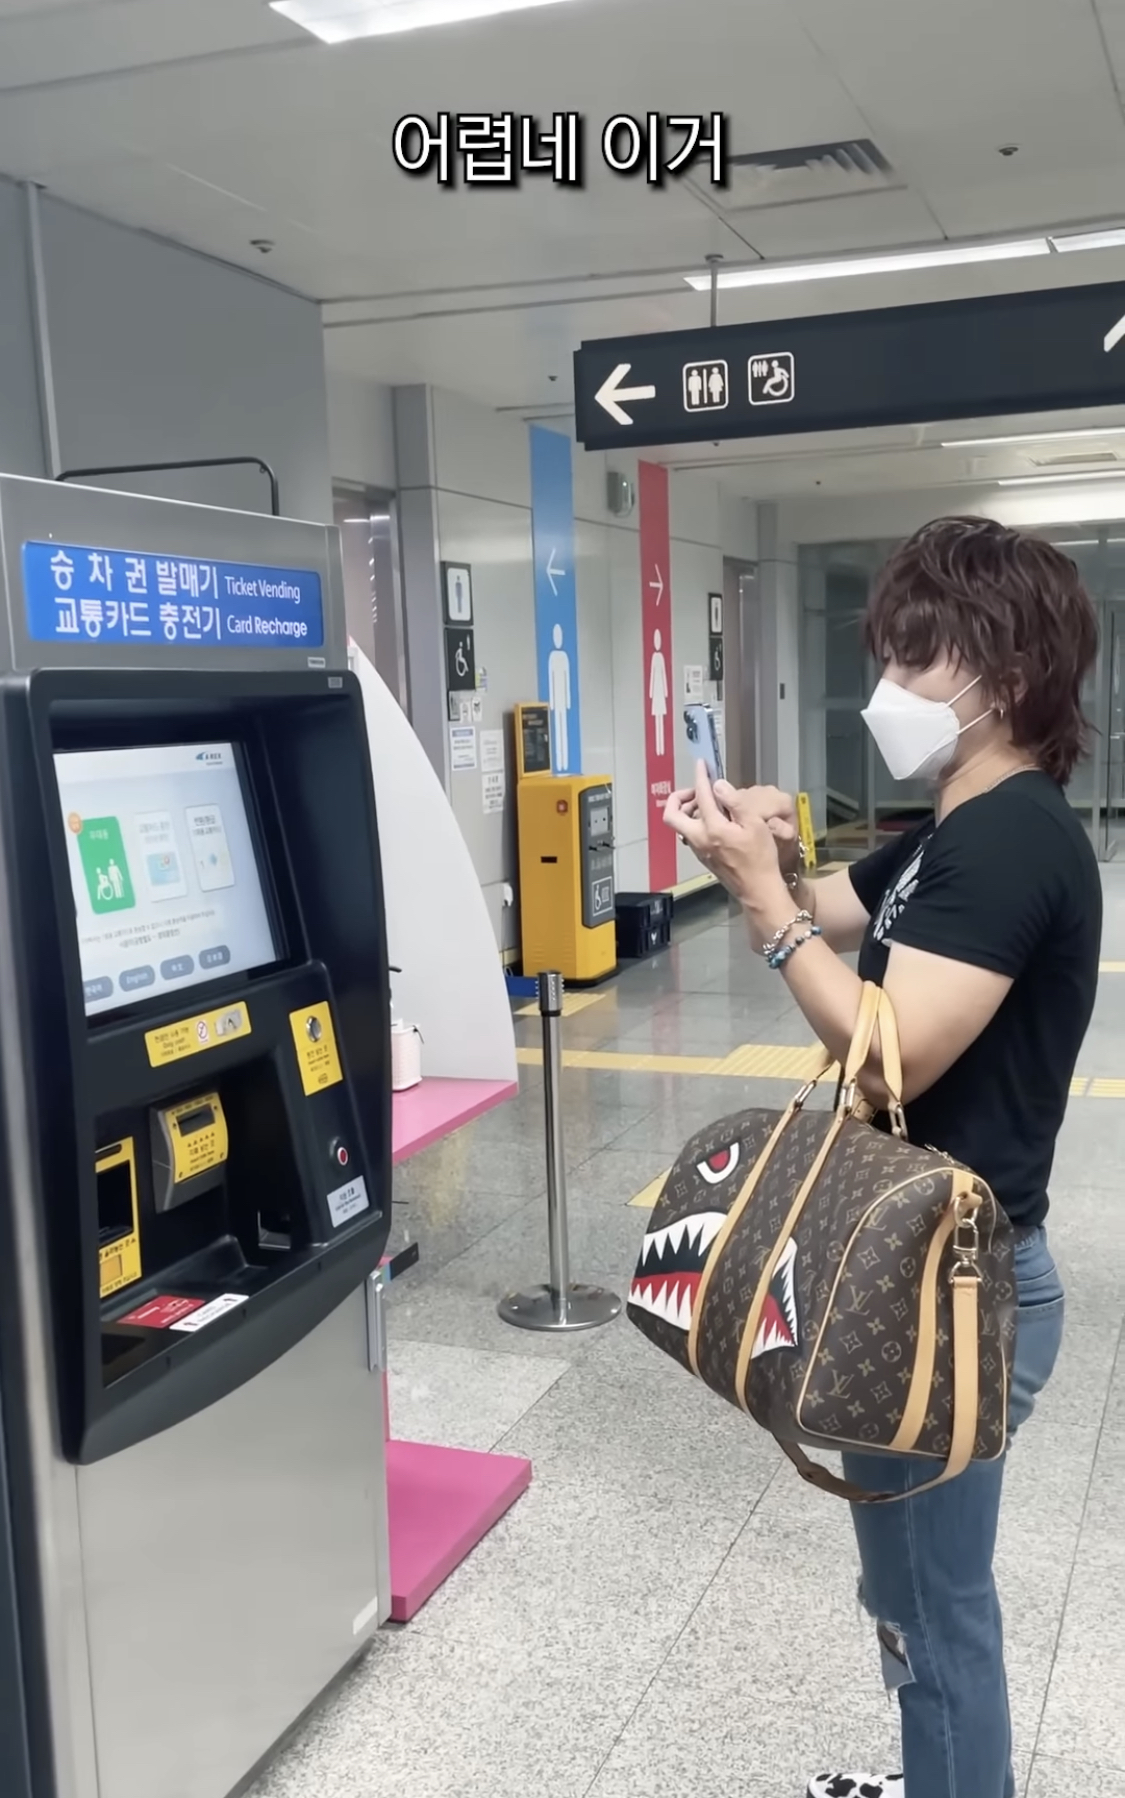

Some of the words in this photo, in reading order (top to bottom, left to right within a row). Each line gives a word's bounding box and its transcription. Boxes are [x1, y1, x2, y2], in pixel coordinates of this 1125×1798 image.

[156, 560, 219, 600] 발매기
[224, 575, 258, 597] Ticket
[257, 579, 301, 605] Vending
[54, 597, 152, 638] 교통카드
[159, 602, 221, 641] 충전기
[226, 614, 253, 634] Card
[254, 616, 308, 639] Recharge
